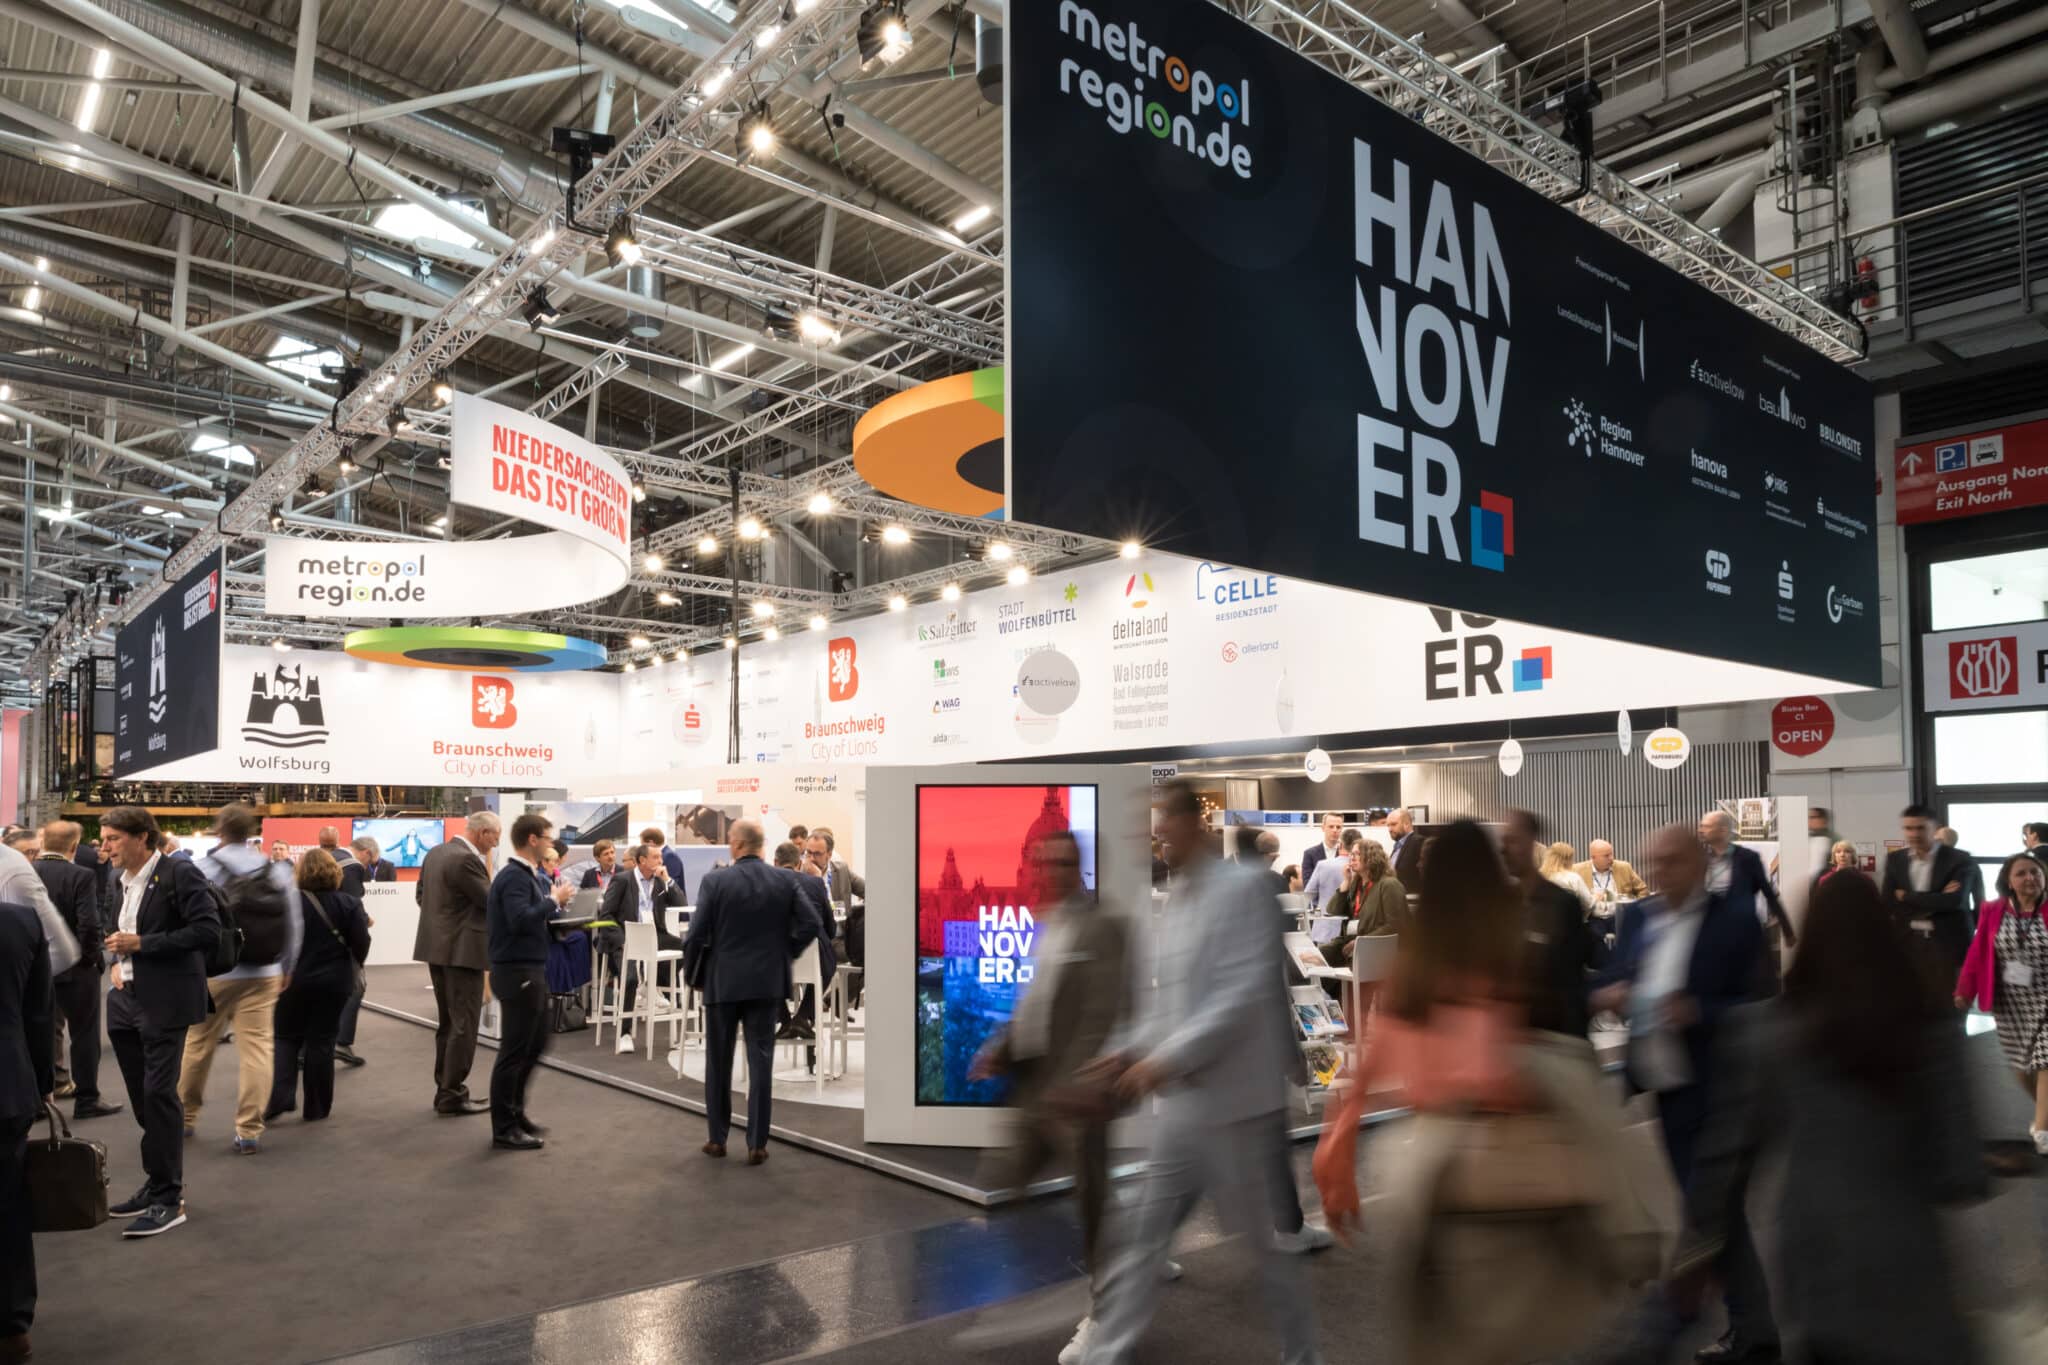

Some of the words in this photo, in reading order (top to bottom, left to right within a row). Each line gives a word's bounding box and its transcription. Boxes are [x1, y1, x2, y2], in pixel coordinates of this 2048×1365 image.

[1059, 0, 1250, 127] metropol
[1060, 57, 1252, 179] region.de
[1353, 136, 1511, 328] HAN
[1355, 274, 1511, 447] NOV
[1600, 416, 1633, 442] Region
[1600, 441, 1645, 467] Hannover
[1691, 448, 1728, 479] hanova
[492, 457, 541, 503] DAS
[545, 476, 579, 514] IST
[1356, 412, 1462, 563] ER
[1935, 473, 2008, 494] Ausgang
[1935, 497, 1964, 511] Exit
[1967, 487, 2013, 506] North
[298, 553, 425, 582] metropol
[298, 579, 426, 606] region.de
[1214, 574, 1279, 605] CELLE
[998, 600, 1024, 618] STADT
[999, 606, 1077, 635] WOLFENBÜTTEL
[1215, 604, 1278, 622] RESIDENZSTADT
[928, 619, 977, 641] Salzgitter
[1112, 611, 1168, 641] deltaland
[1113, 660, 1168, 684] Walsrode
[1425, 634, 1504, 701] ER
[942, 697, 960, 709] WAG
[805, 713, 885, 739] Braunschweig
[1778, 729, 1823, 744] OPEN
[433, 741, 554, 761] Braunschweig
[811, 743, 834, 762] City
[835, 740, 847, 758] of
[849, 739, 878, 757] Lions
[240, 756, 330, 774] Wolfsburg
[444, 760, 477, 777] City
[480, 759, 496, 776] of
[502, 760, 543, 777] Lions
[1152, 768, 1175, 778] expo
[794, 775, 837, 785] metropol
[794, 783, 838, 794] region.de
[979, 905, 1034, 931] HAN
[979, 931, 1034, 957] NOV
[979, 957, 1015, 983] ER
